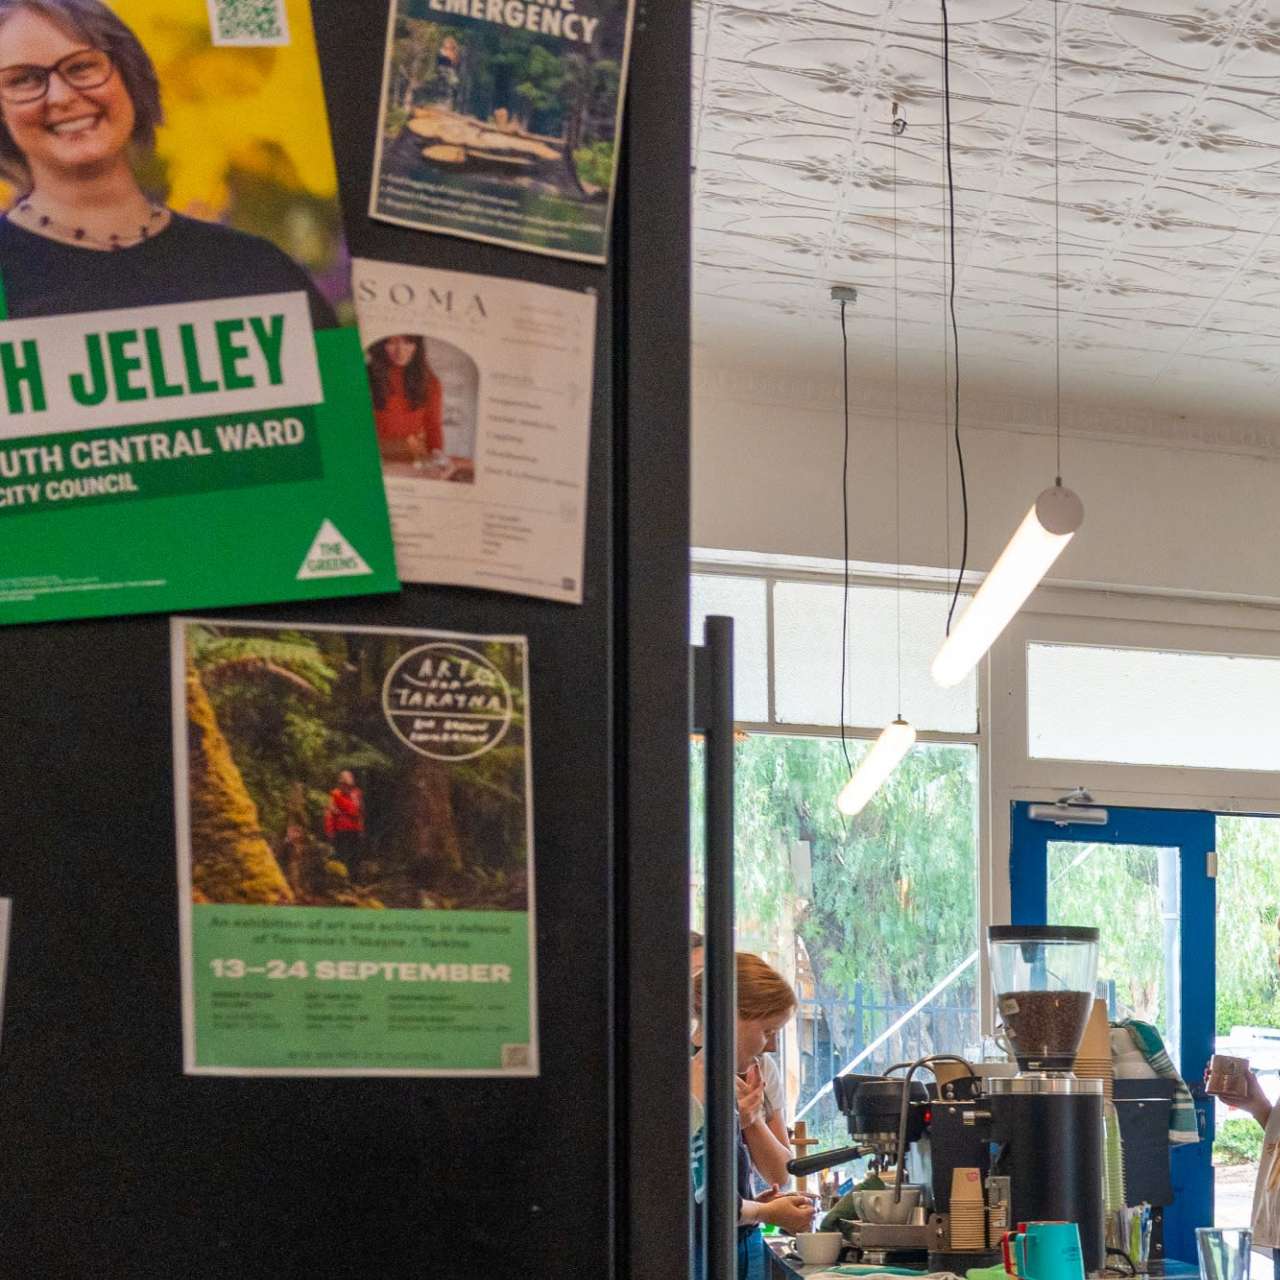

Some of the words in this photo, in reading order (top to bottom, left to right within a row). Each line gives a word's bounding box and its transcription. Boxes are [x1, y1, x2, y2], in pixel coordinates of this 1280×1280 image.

[359, 279, 488, 318] SOMA
[0, 339, 47, 415] H
[69, 314, 285, 407] JELLEY
[0, 444, 64, 478] UTH
[70, 429, 213, 470] CENTRAL
[216, 418, 305, 452] WARD
[46, 472, 139, 500] COUNCIL
[320, 543, 342, 556] THE
[315, 960, 512, 982] SEPTEMBER
